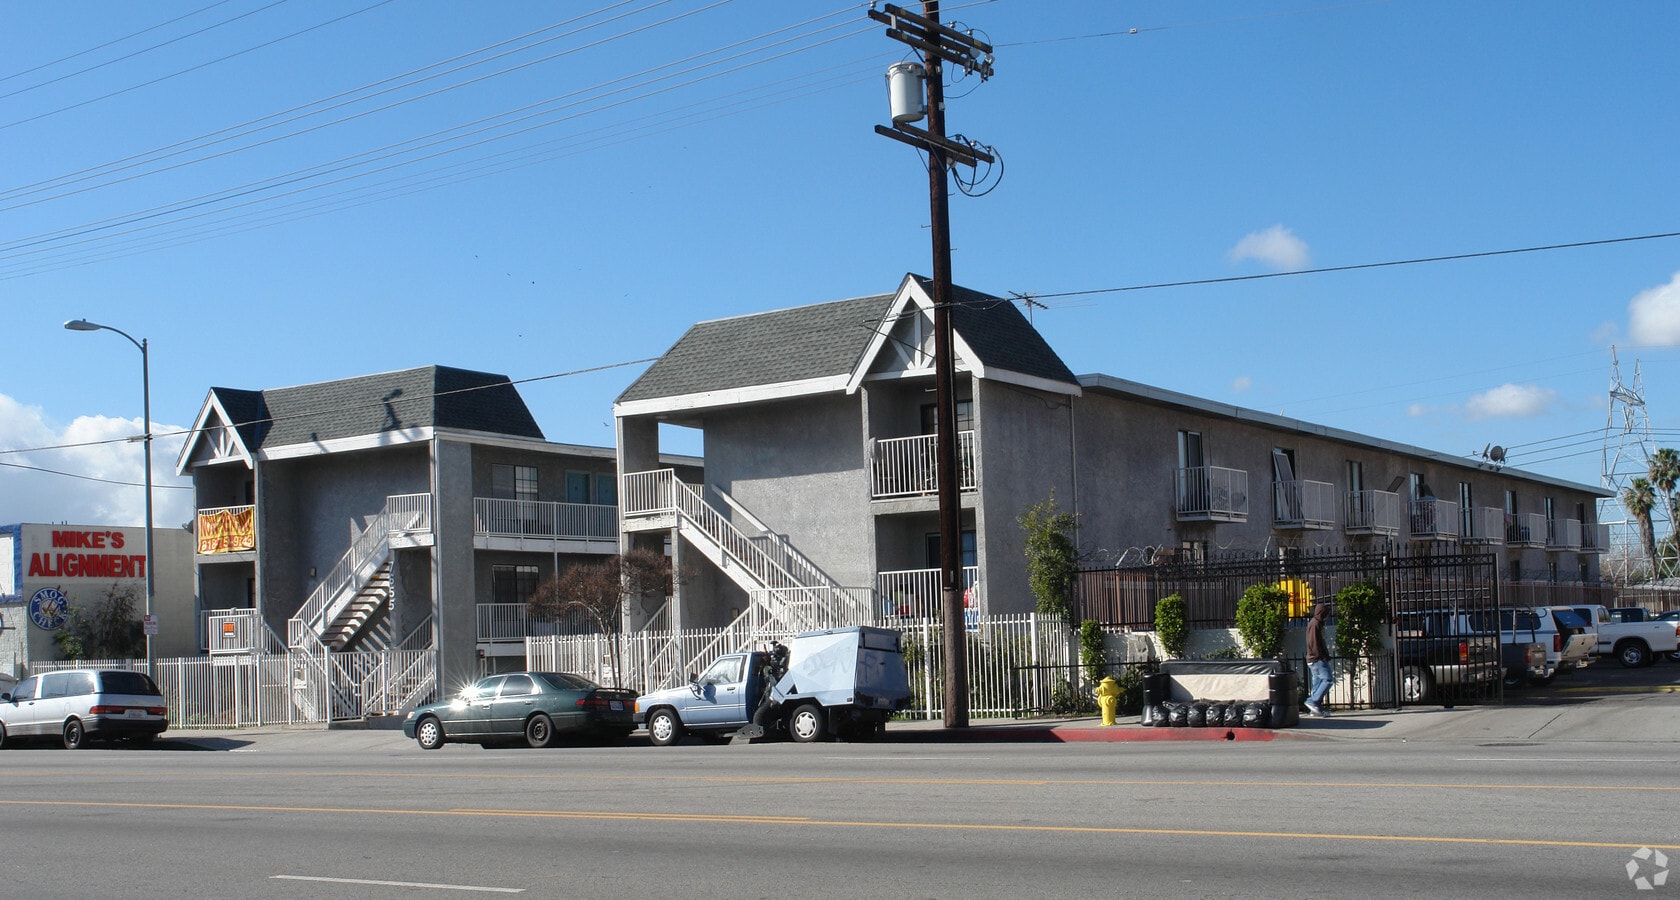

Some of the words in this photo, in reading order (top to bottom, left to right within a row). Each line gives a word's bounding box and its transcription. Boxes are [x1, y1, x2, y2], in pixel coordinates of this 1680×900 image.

[52, 530, 125, 549] MIKE'S
[28, 552, 146, 578] ALIGNMENT
[34, 590, 66, 605] SMOG
